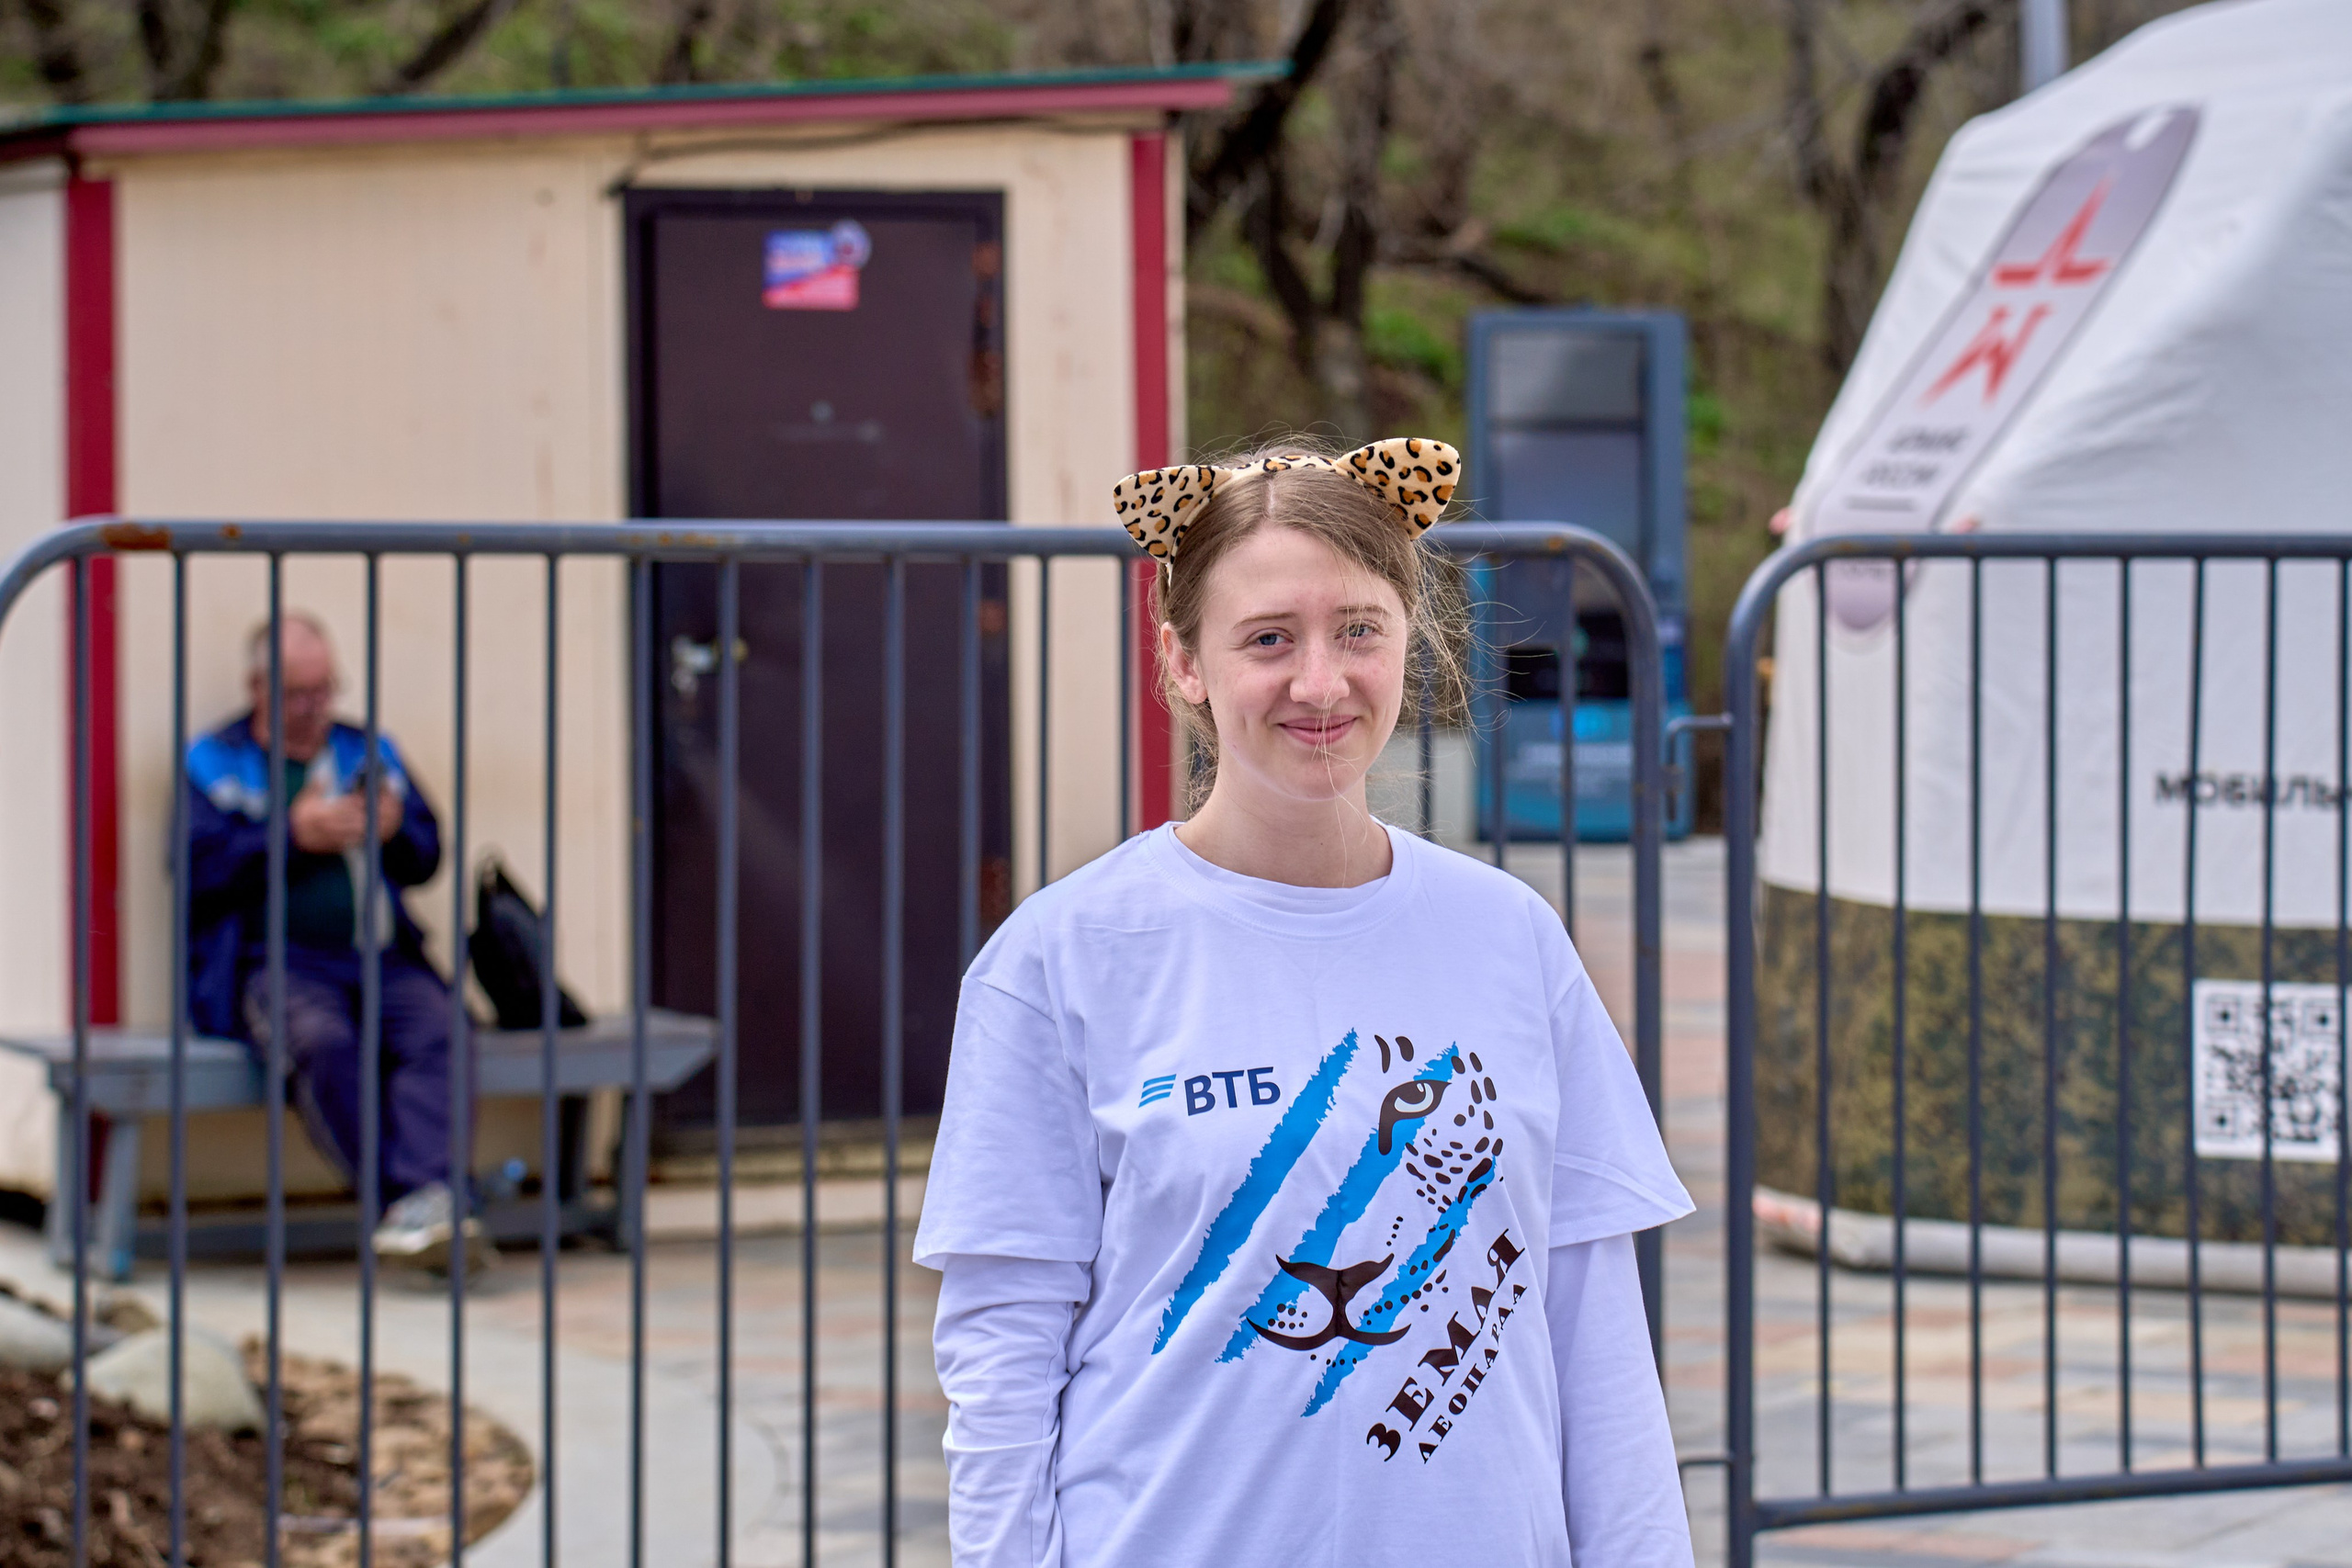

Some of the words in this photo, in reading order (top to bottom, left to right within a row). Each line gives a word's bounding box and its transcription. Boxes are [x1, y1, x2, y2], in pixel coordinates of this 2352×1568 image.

[2155, 771, 2352, 809] МОБИЛЬ
[1183, 1066, 1281, 1117] ВТБ
[1365, 1227, 1527, 1462] ЗЕМЛЯ
[1417, 1282, 1528, 1466] ЛЕОПАРДА
